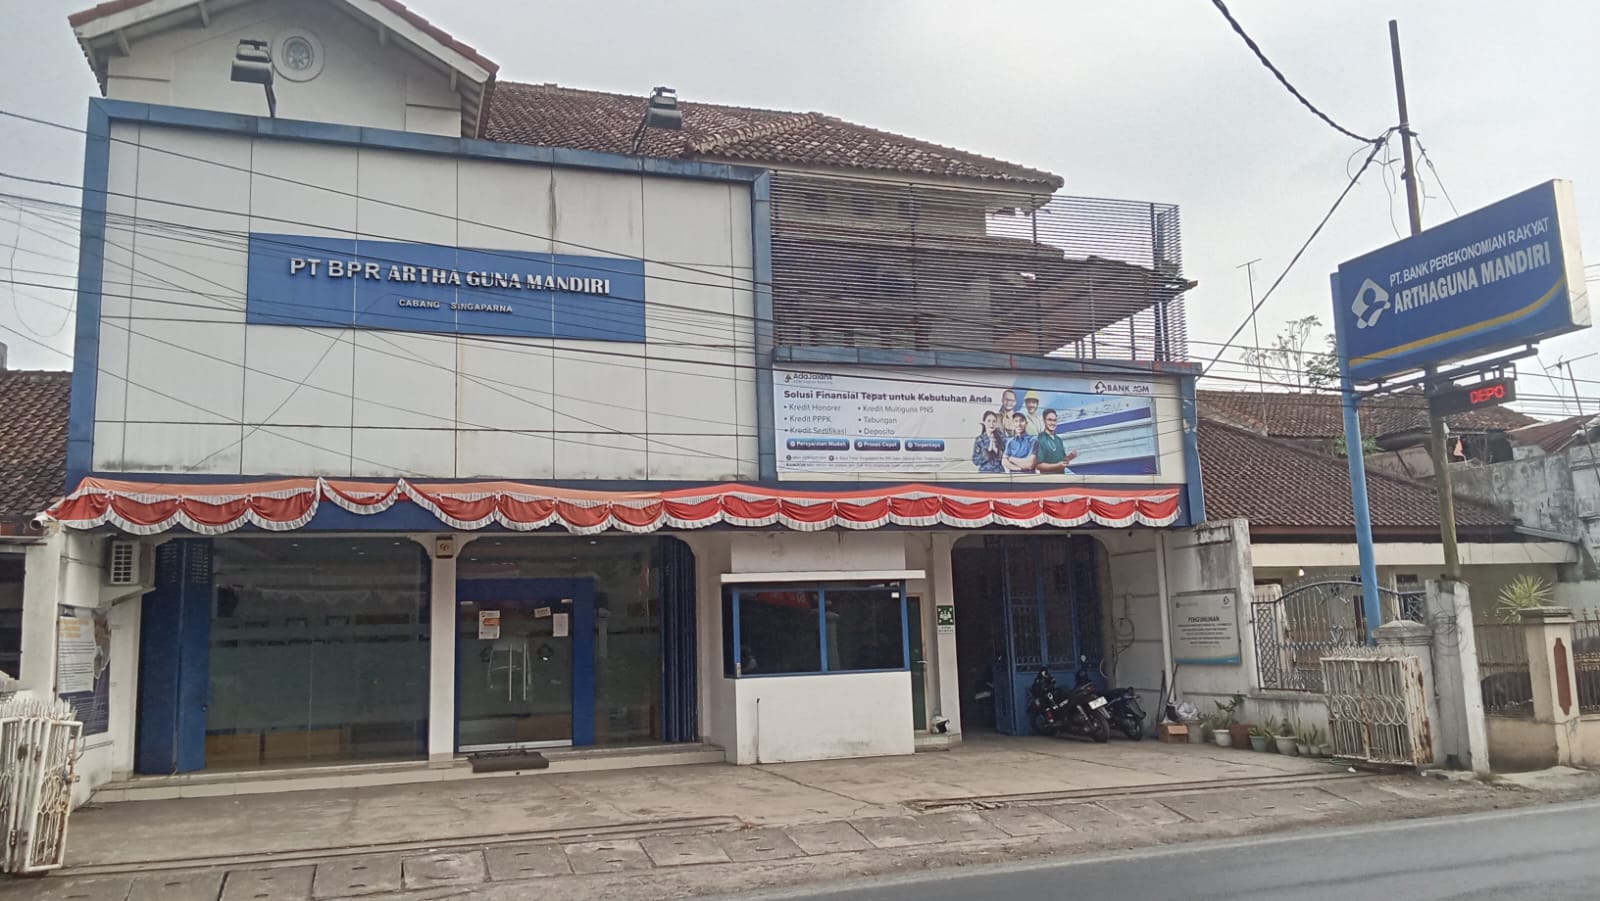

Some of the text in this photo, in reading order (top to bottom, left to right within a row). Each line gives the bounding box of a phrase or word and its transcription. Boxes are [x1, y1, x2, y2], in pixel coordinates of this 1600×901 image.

[1389, 217, 1549, 287] PT. BANK PEREKONOMIAN RAKYAT
[290, 257, 611, 294] PT BPR ARTHA GUNA MANDIRI
[1394, 241, 1551, 315] ARTHAGUNA MANDIRI
[399, 298, 513, 313] CABANG SINGAPARNA
[1107, 384, 1130, 392] BANK
[1469, 384, 1505, 405] DEPO
[784, 390, 993, 403] Solusi Finansial Tepat untuk Kebutuhan Anda
[884, 406, 918, 414] Multiguna
[863, 416, 897, 425] Tabungan
[863, 427, 895, 436] Deposito
